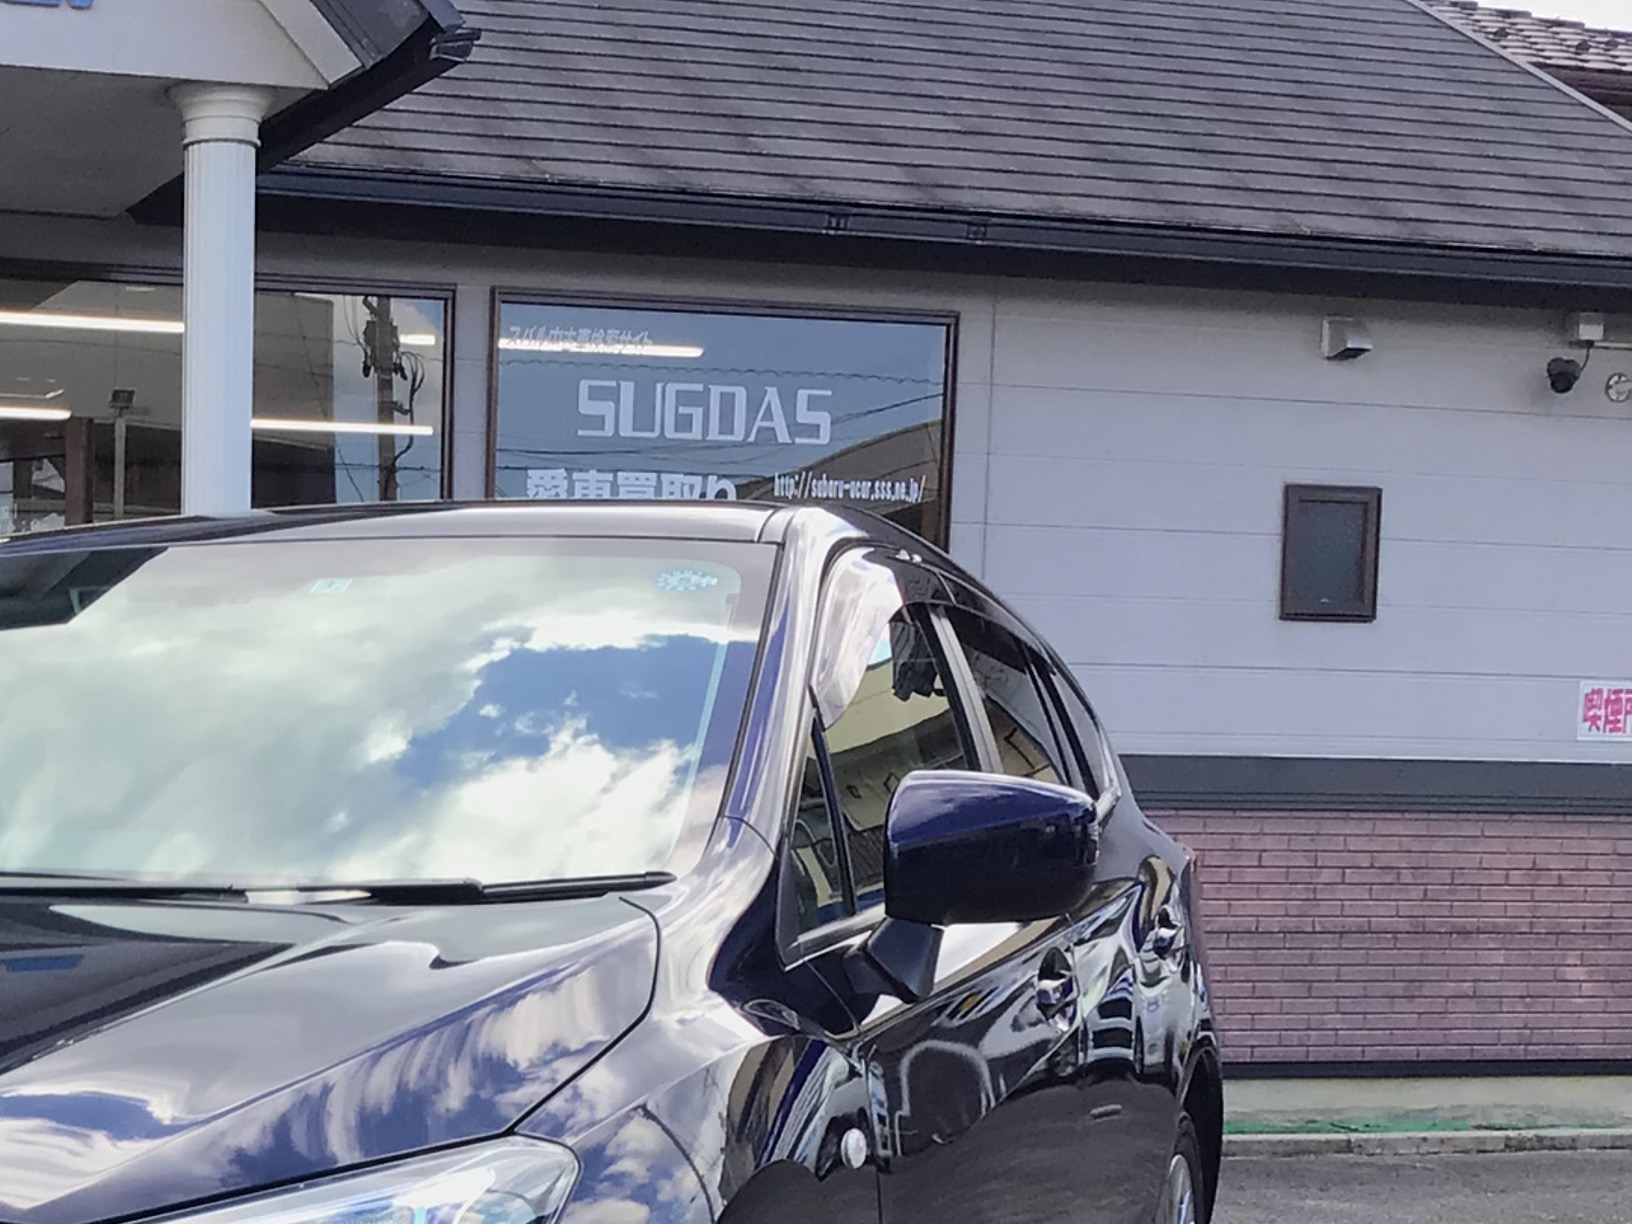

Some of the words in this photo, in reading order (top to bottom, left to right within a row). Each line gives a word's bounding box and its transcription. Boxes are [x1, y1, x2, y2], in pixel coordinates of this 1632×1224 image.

[576, 378, 833, 445] SUGDAS
[527, 468, 737, 500] 愛車買取り
